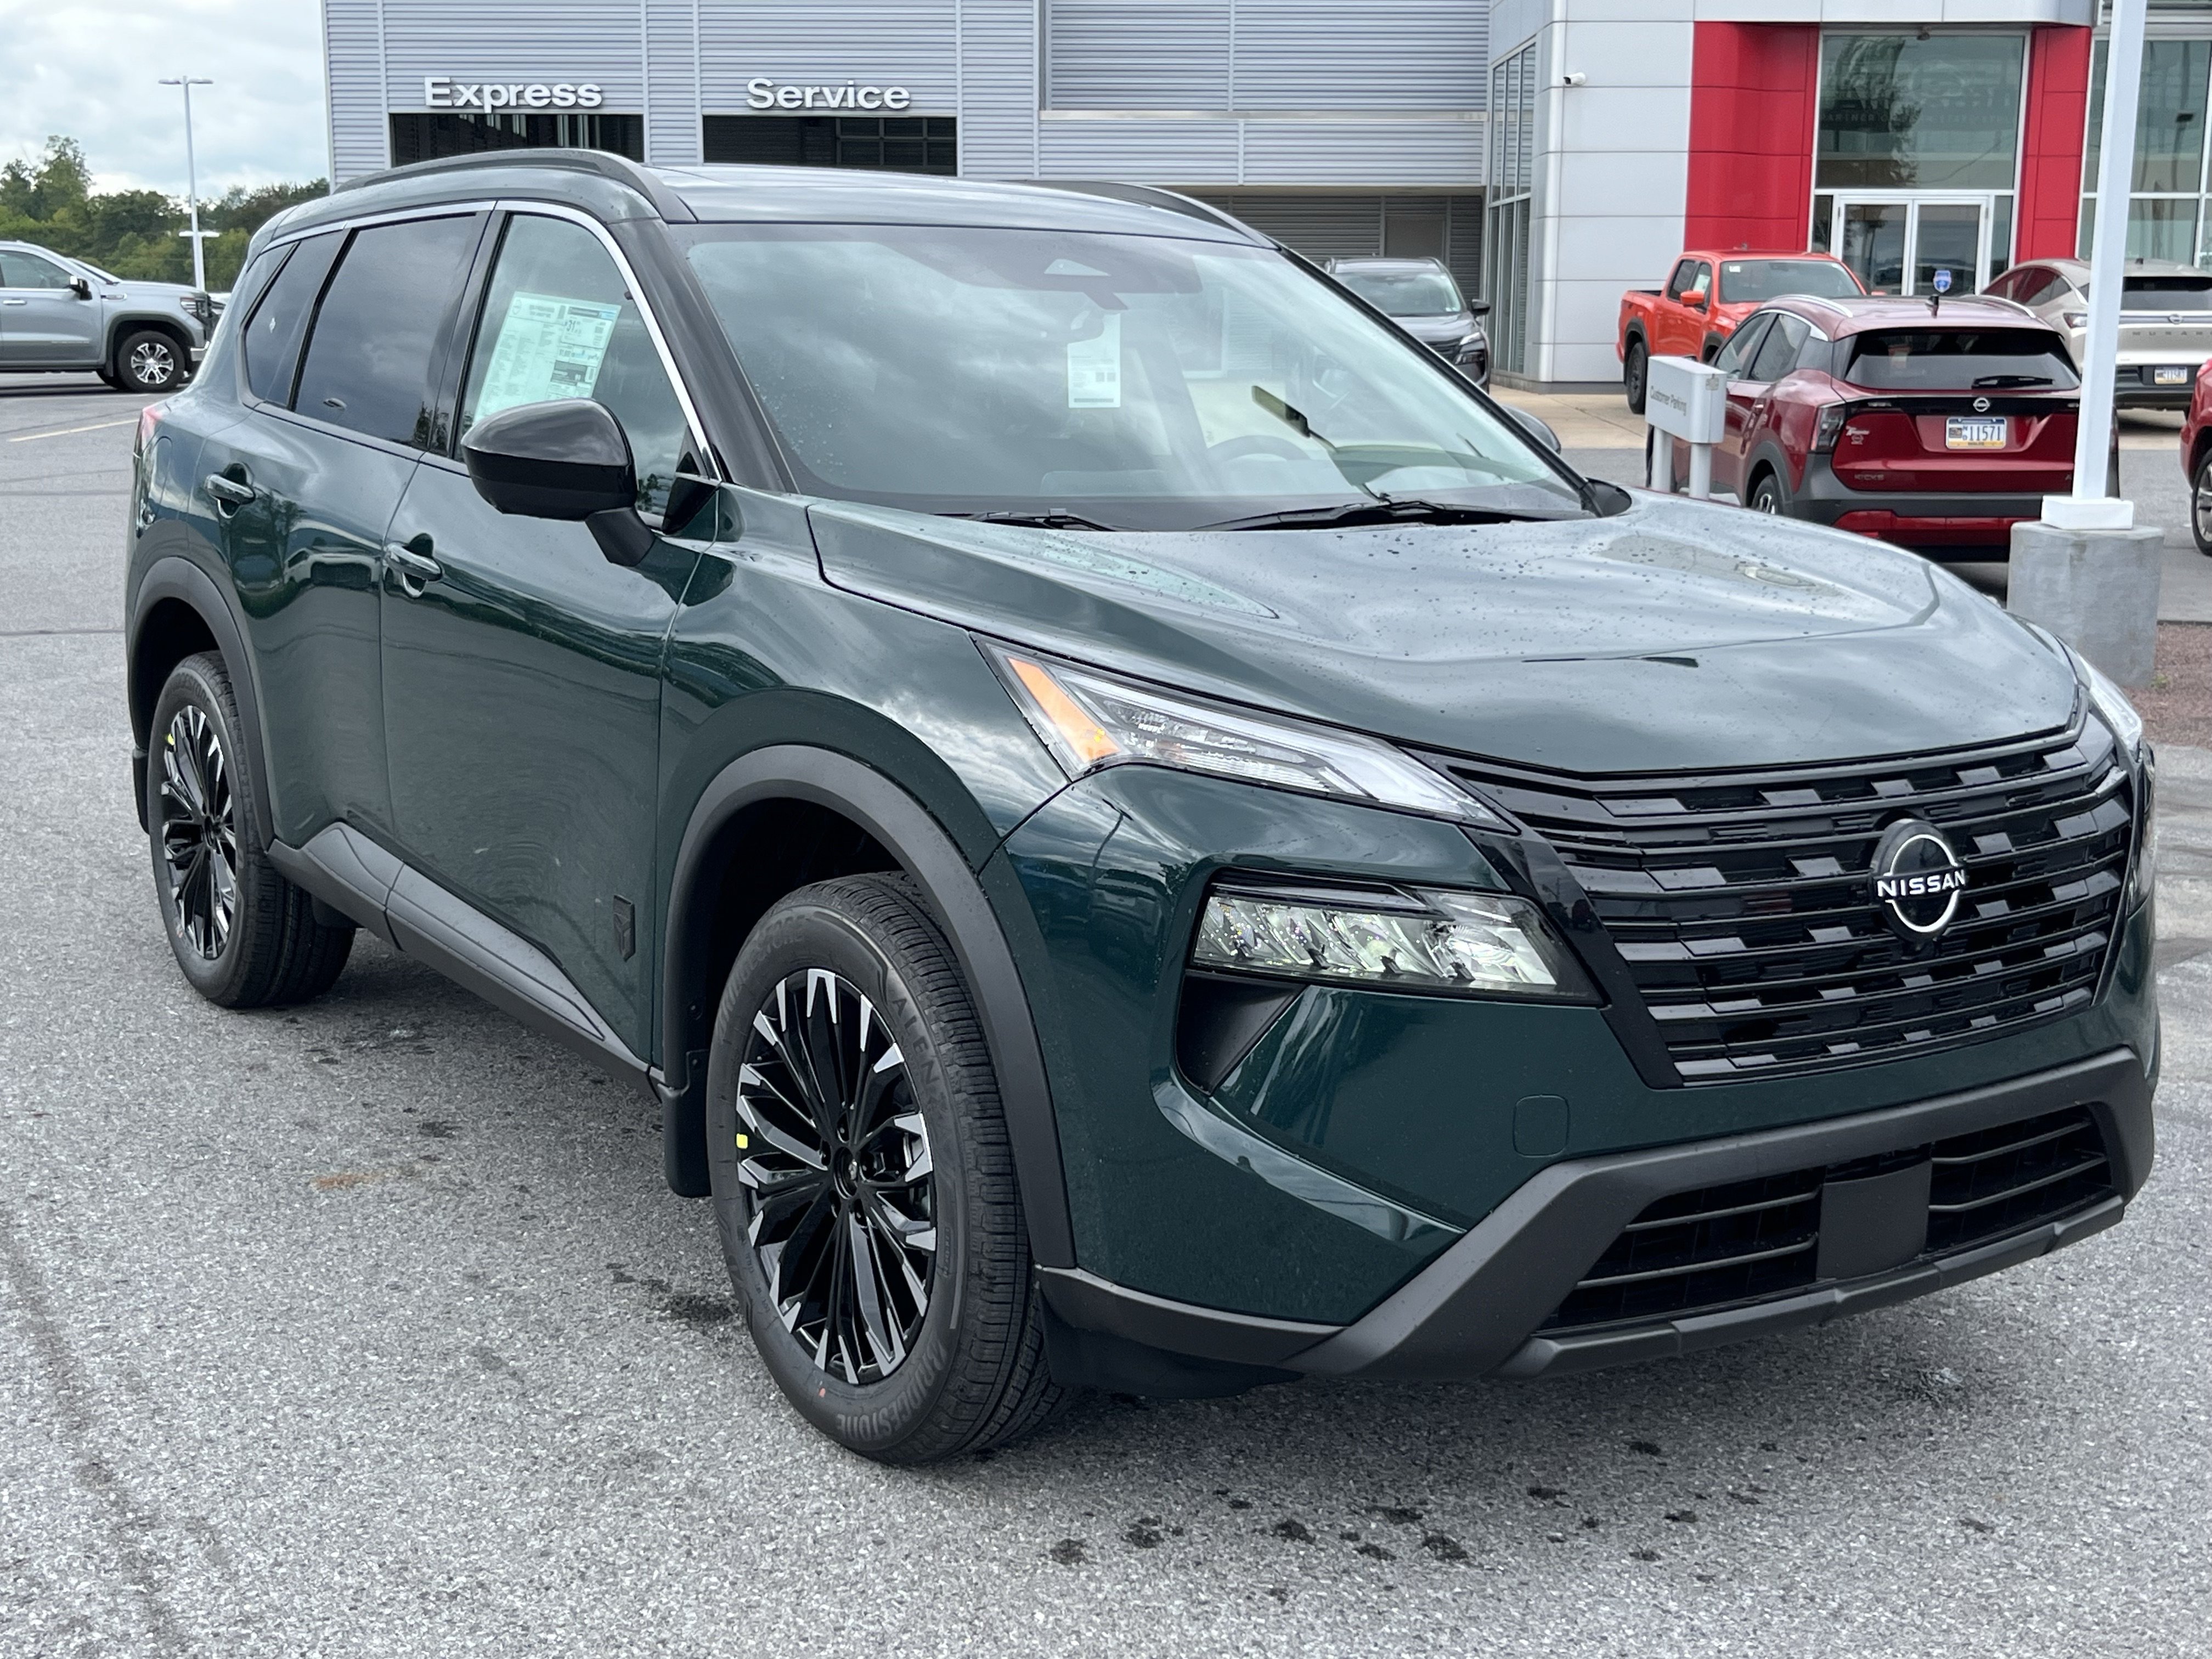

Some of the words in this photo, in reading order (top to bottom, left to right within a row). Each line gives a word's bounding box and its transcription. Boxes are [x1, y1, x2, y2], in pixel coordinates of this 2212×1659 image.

[424, 76, 603, 114] Express
[746, 78, 911, 109] Service
[1968, 425, 2001, 442] 11571
[1877, 869, 1966, 897] NISSAN
[836, 1333, 947, 1442] BRIDGESTONE
